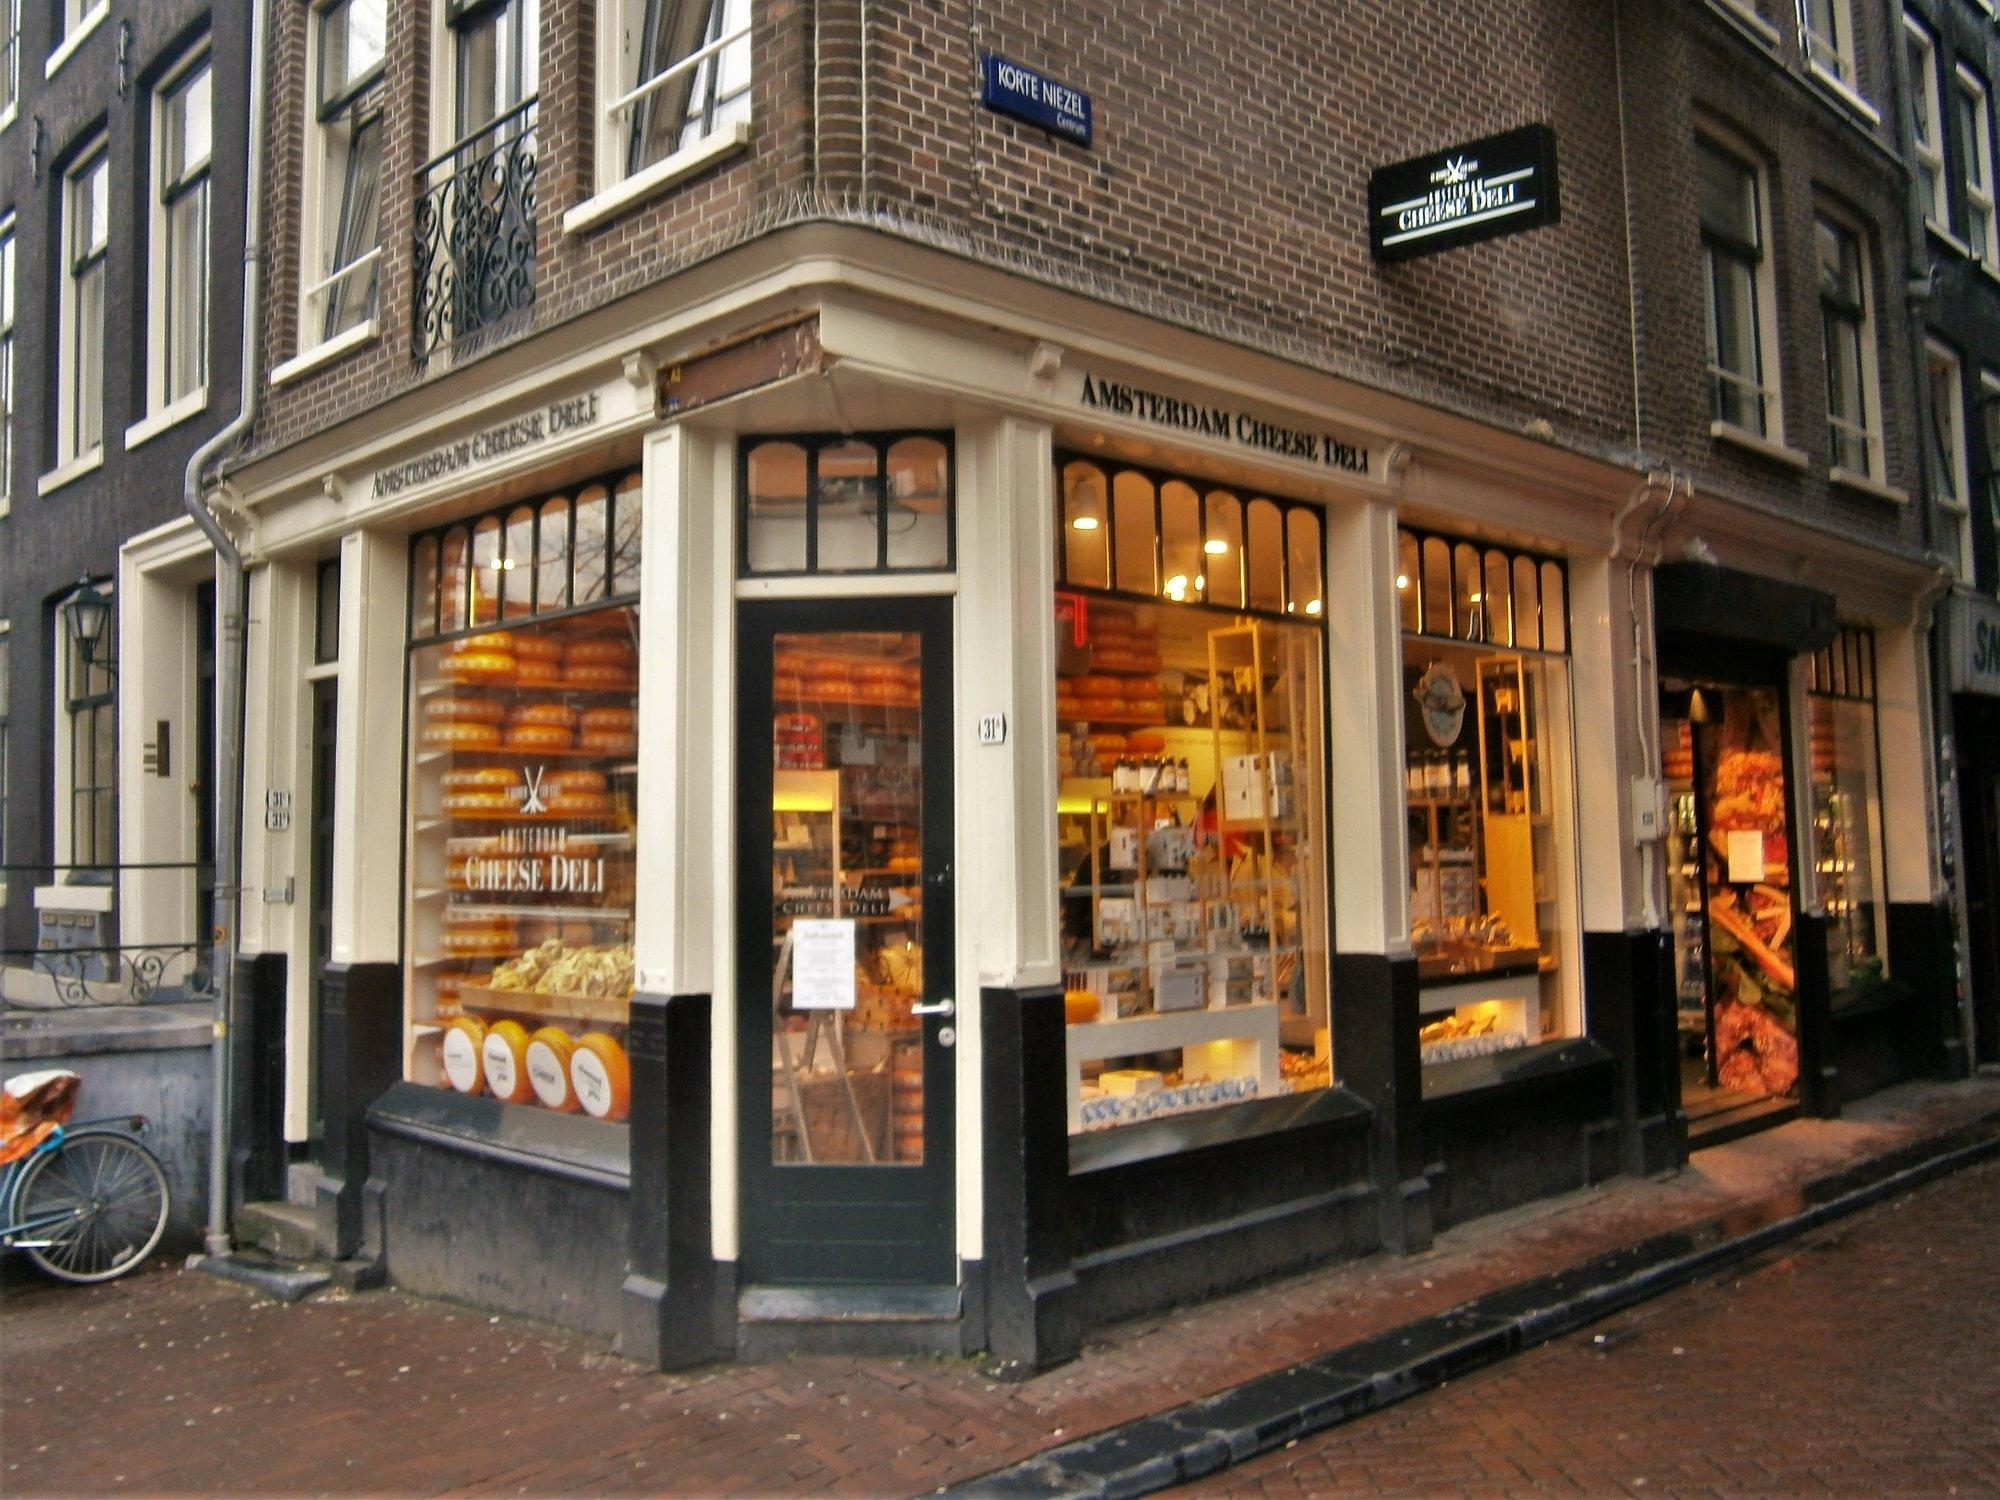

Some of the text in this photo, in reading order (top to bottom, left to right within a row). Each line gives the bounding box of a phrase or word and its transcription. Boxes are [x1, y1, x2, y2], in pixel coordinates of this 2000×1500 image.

[998, 62, 1086, 119] KORTE NIEZEL
[1398, 182, 1516, 231] CHEESE DELI
[371, 390, 599, 500] AMSTERDAM CHEESE DELI
[1081, 373, 1370, 475] AMSTERDAM CHEESE DELI
[464, 853, 605, 893] CHEESE DELI
